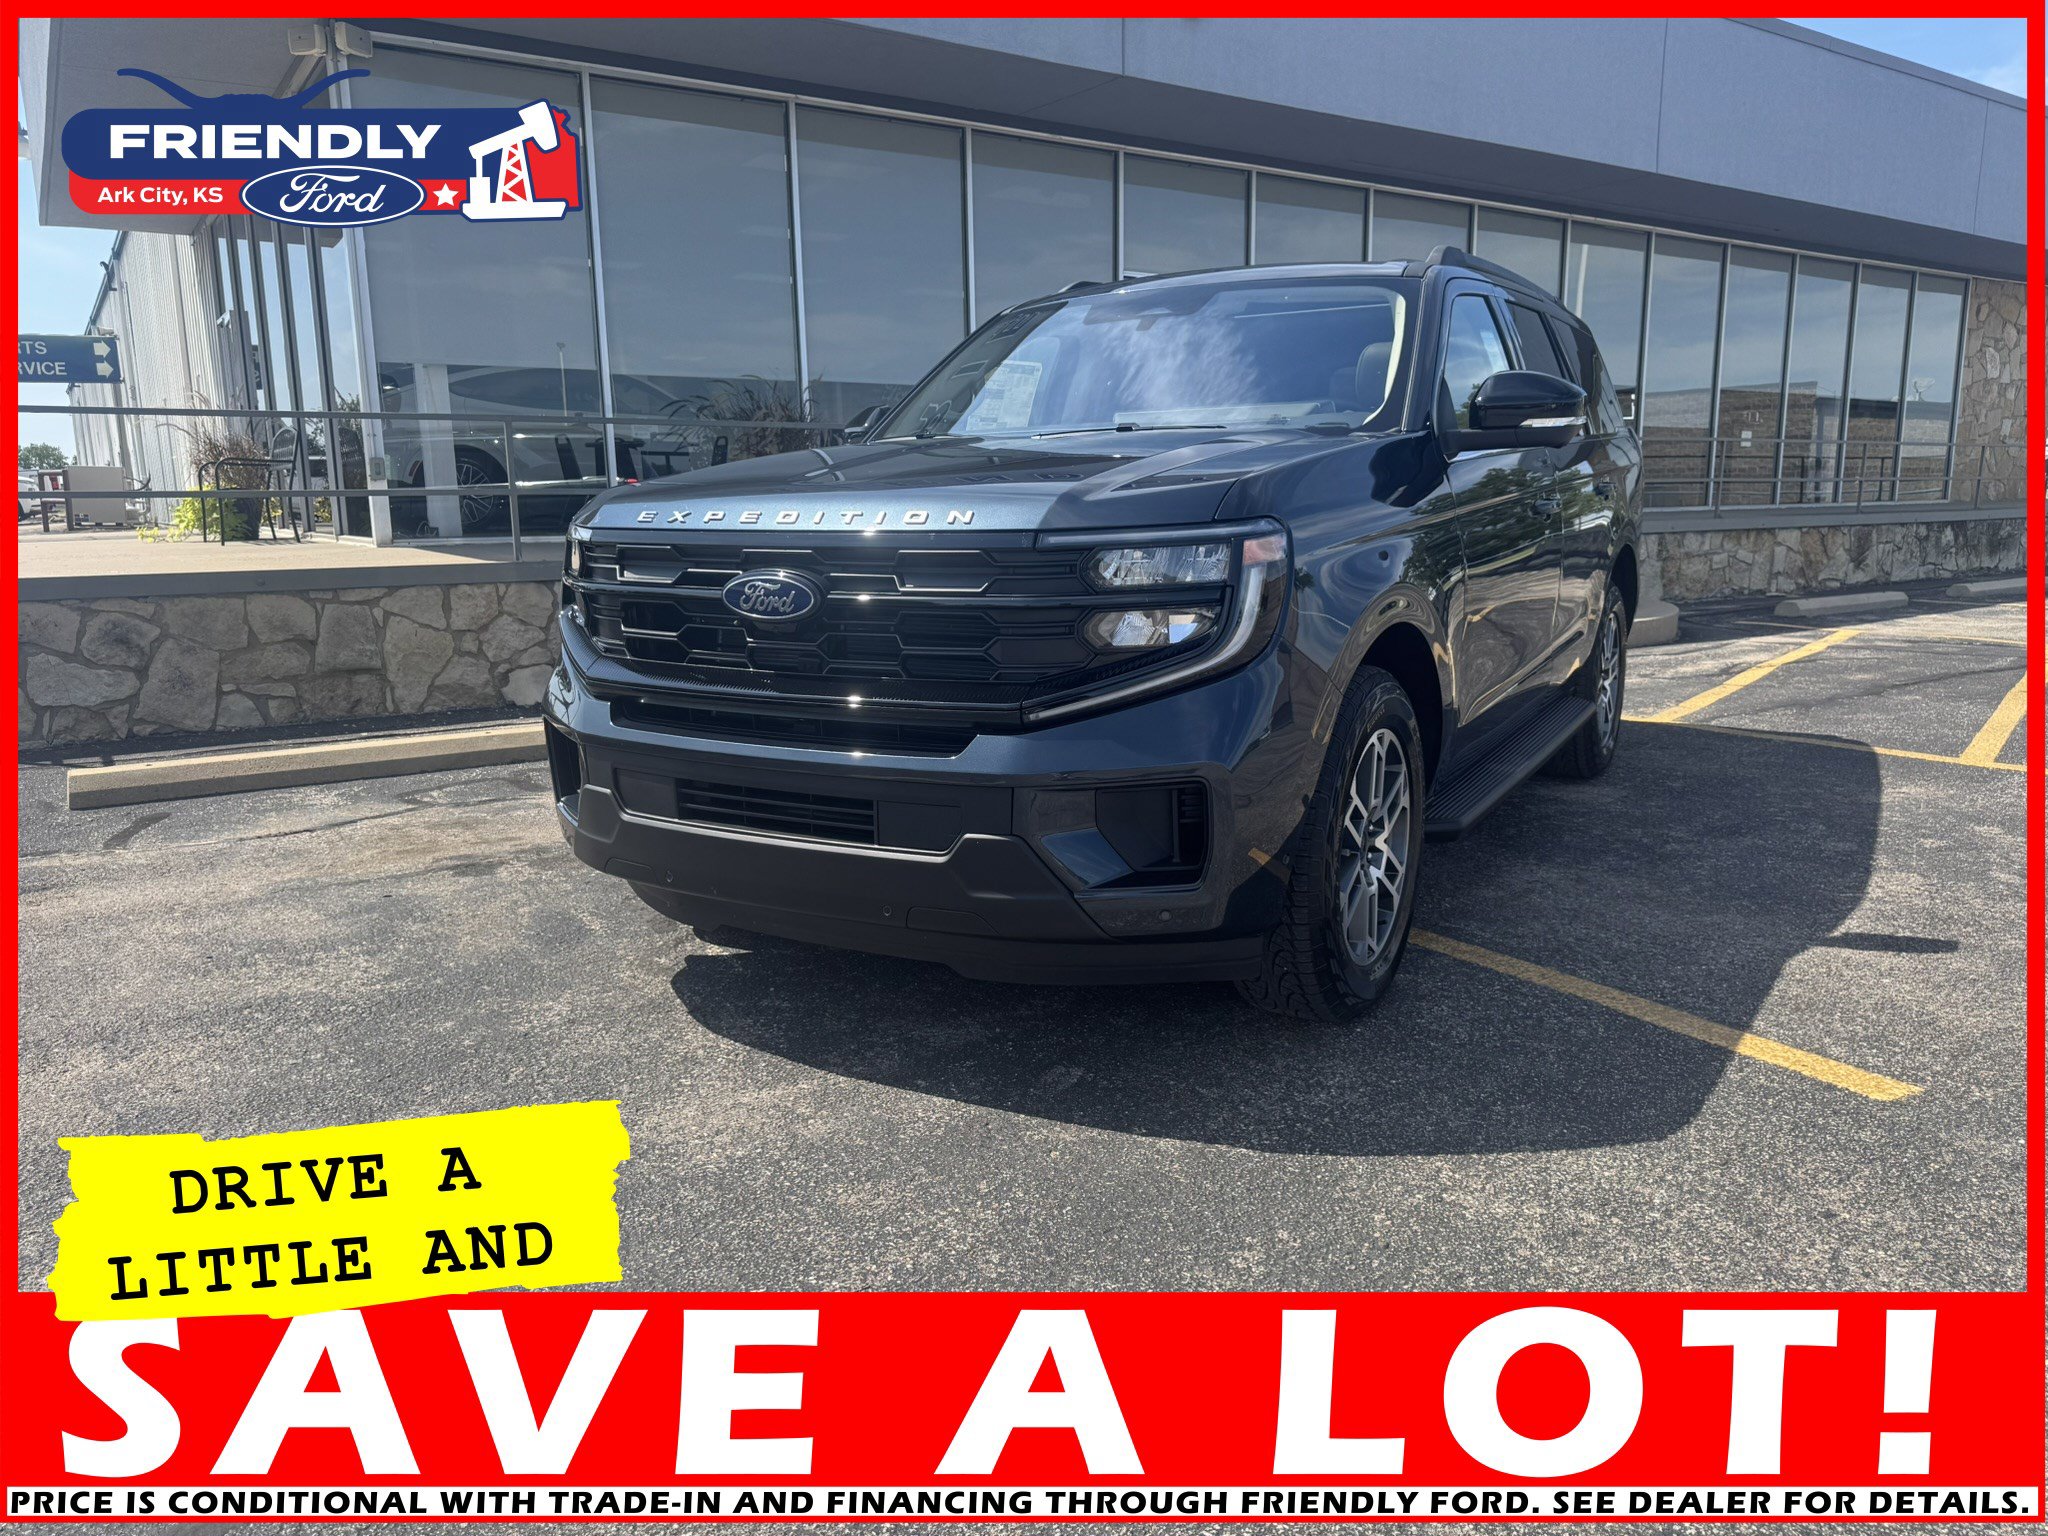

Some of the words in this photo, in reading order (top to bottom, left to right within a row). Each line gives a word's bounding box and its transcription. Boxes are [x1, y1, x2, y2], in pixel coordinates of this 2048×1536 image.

[18, 341, 47, 355] TS
[636, 509, 977, 526] EXPEDITION
[739, 582, 796, 614] Ford
